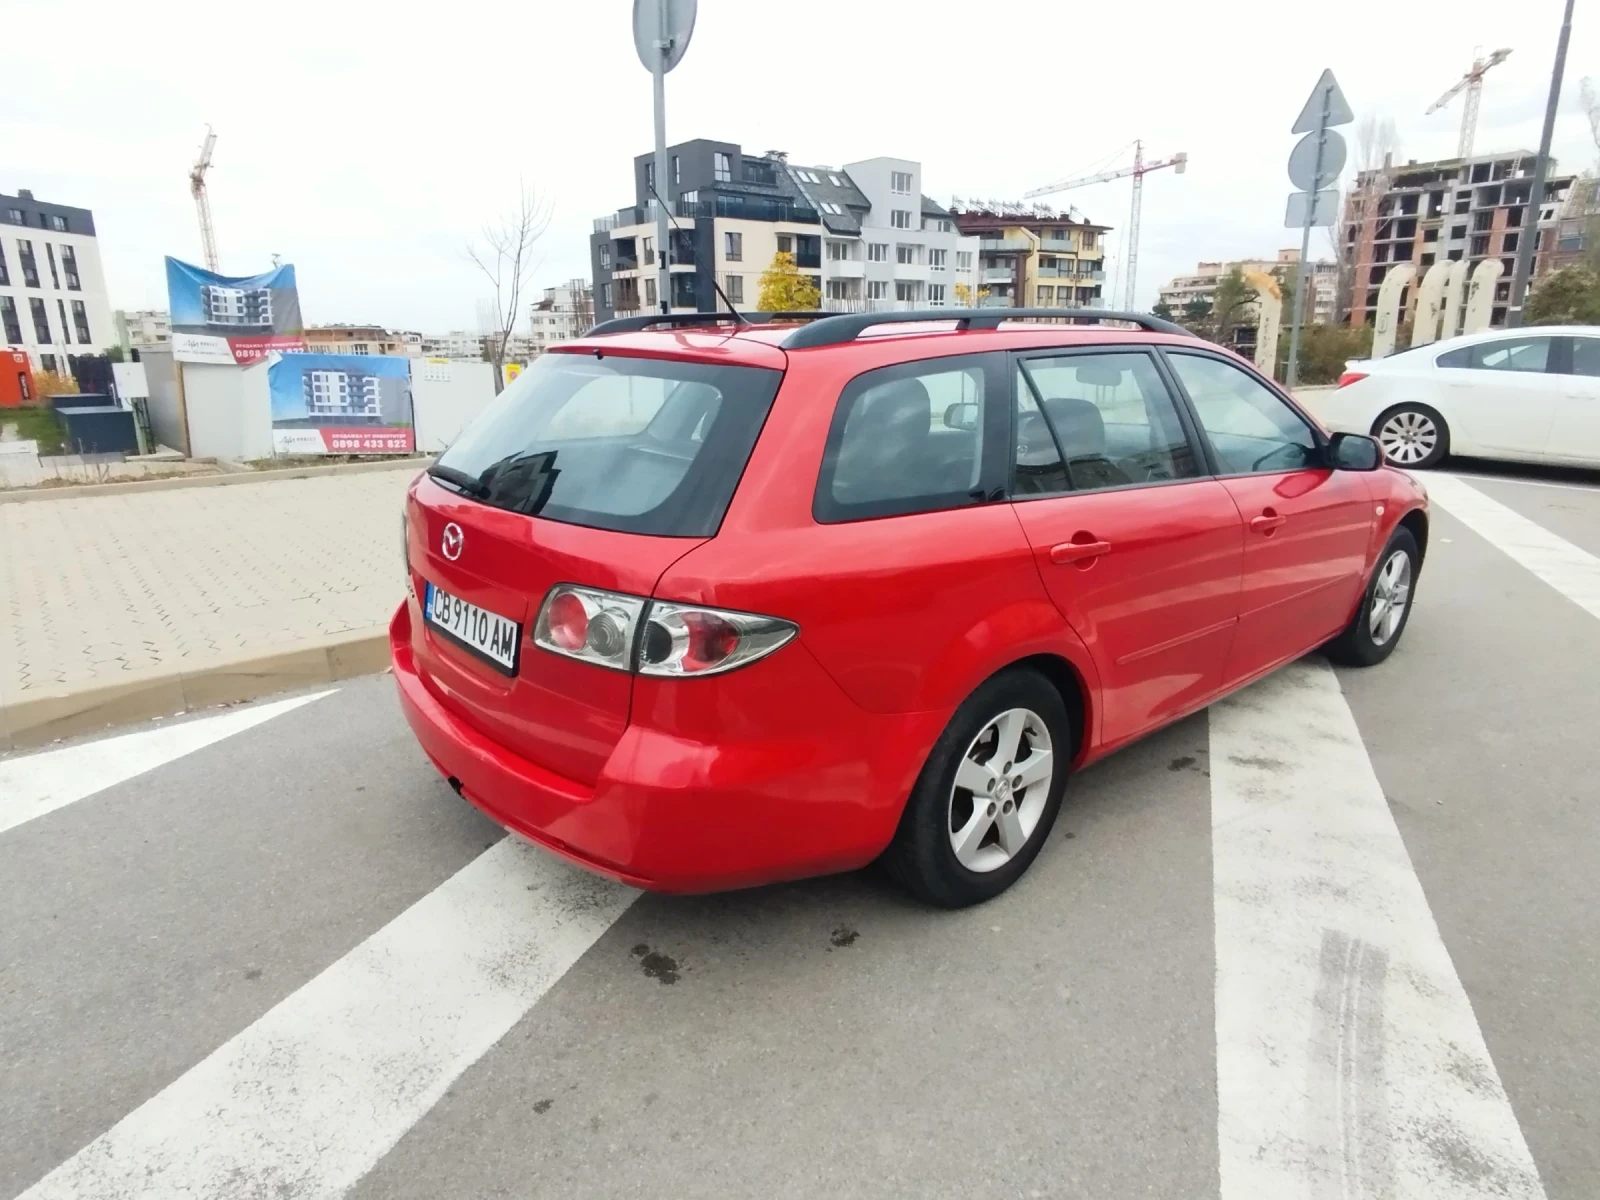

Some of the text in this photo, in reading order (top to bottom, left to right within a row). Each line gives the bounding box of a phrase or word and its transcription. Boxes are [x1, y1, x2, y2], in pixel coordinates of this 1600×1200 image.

[235, 349, 261, 358] 0898
[332, 439, 407, 448] 0898 433 822
[434, 589, 514, 661] CB 9110 AM
